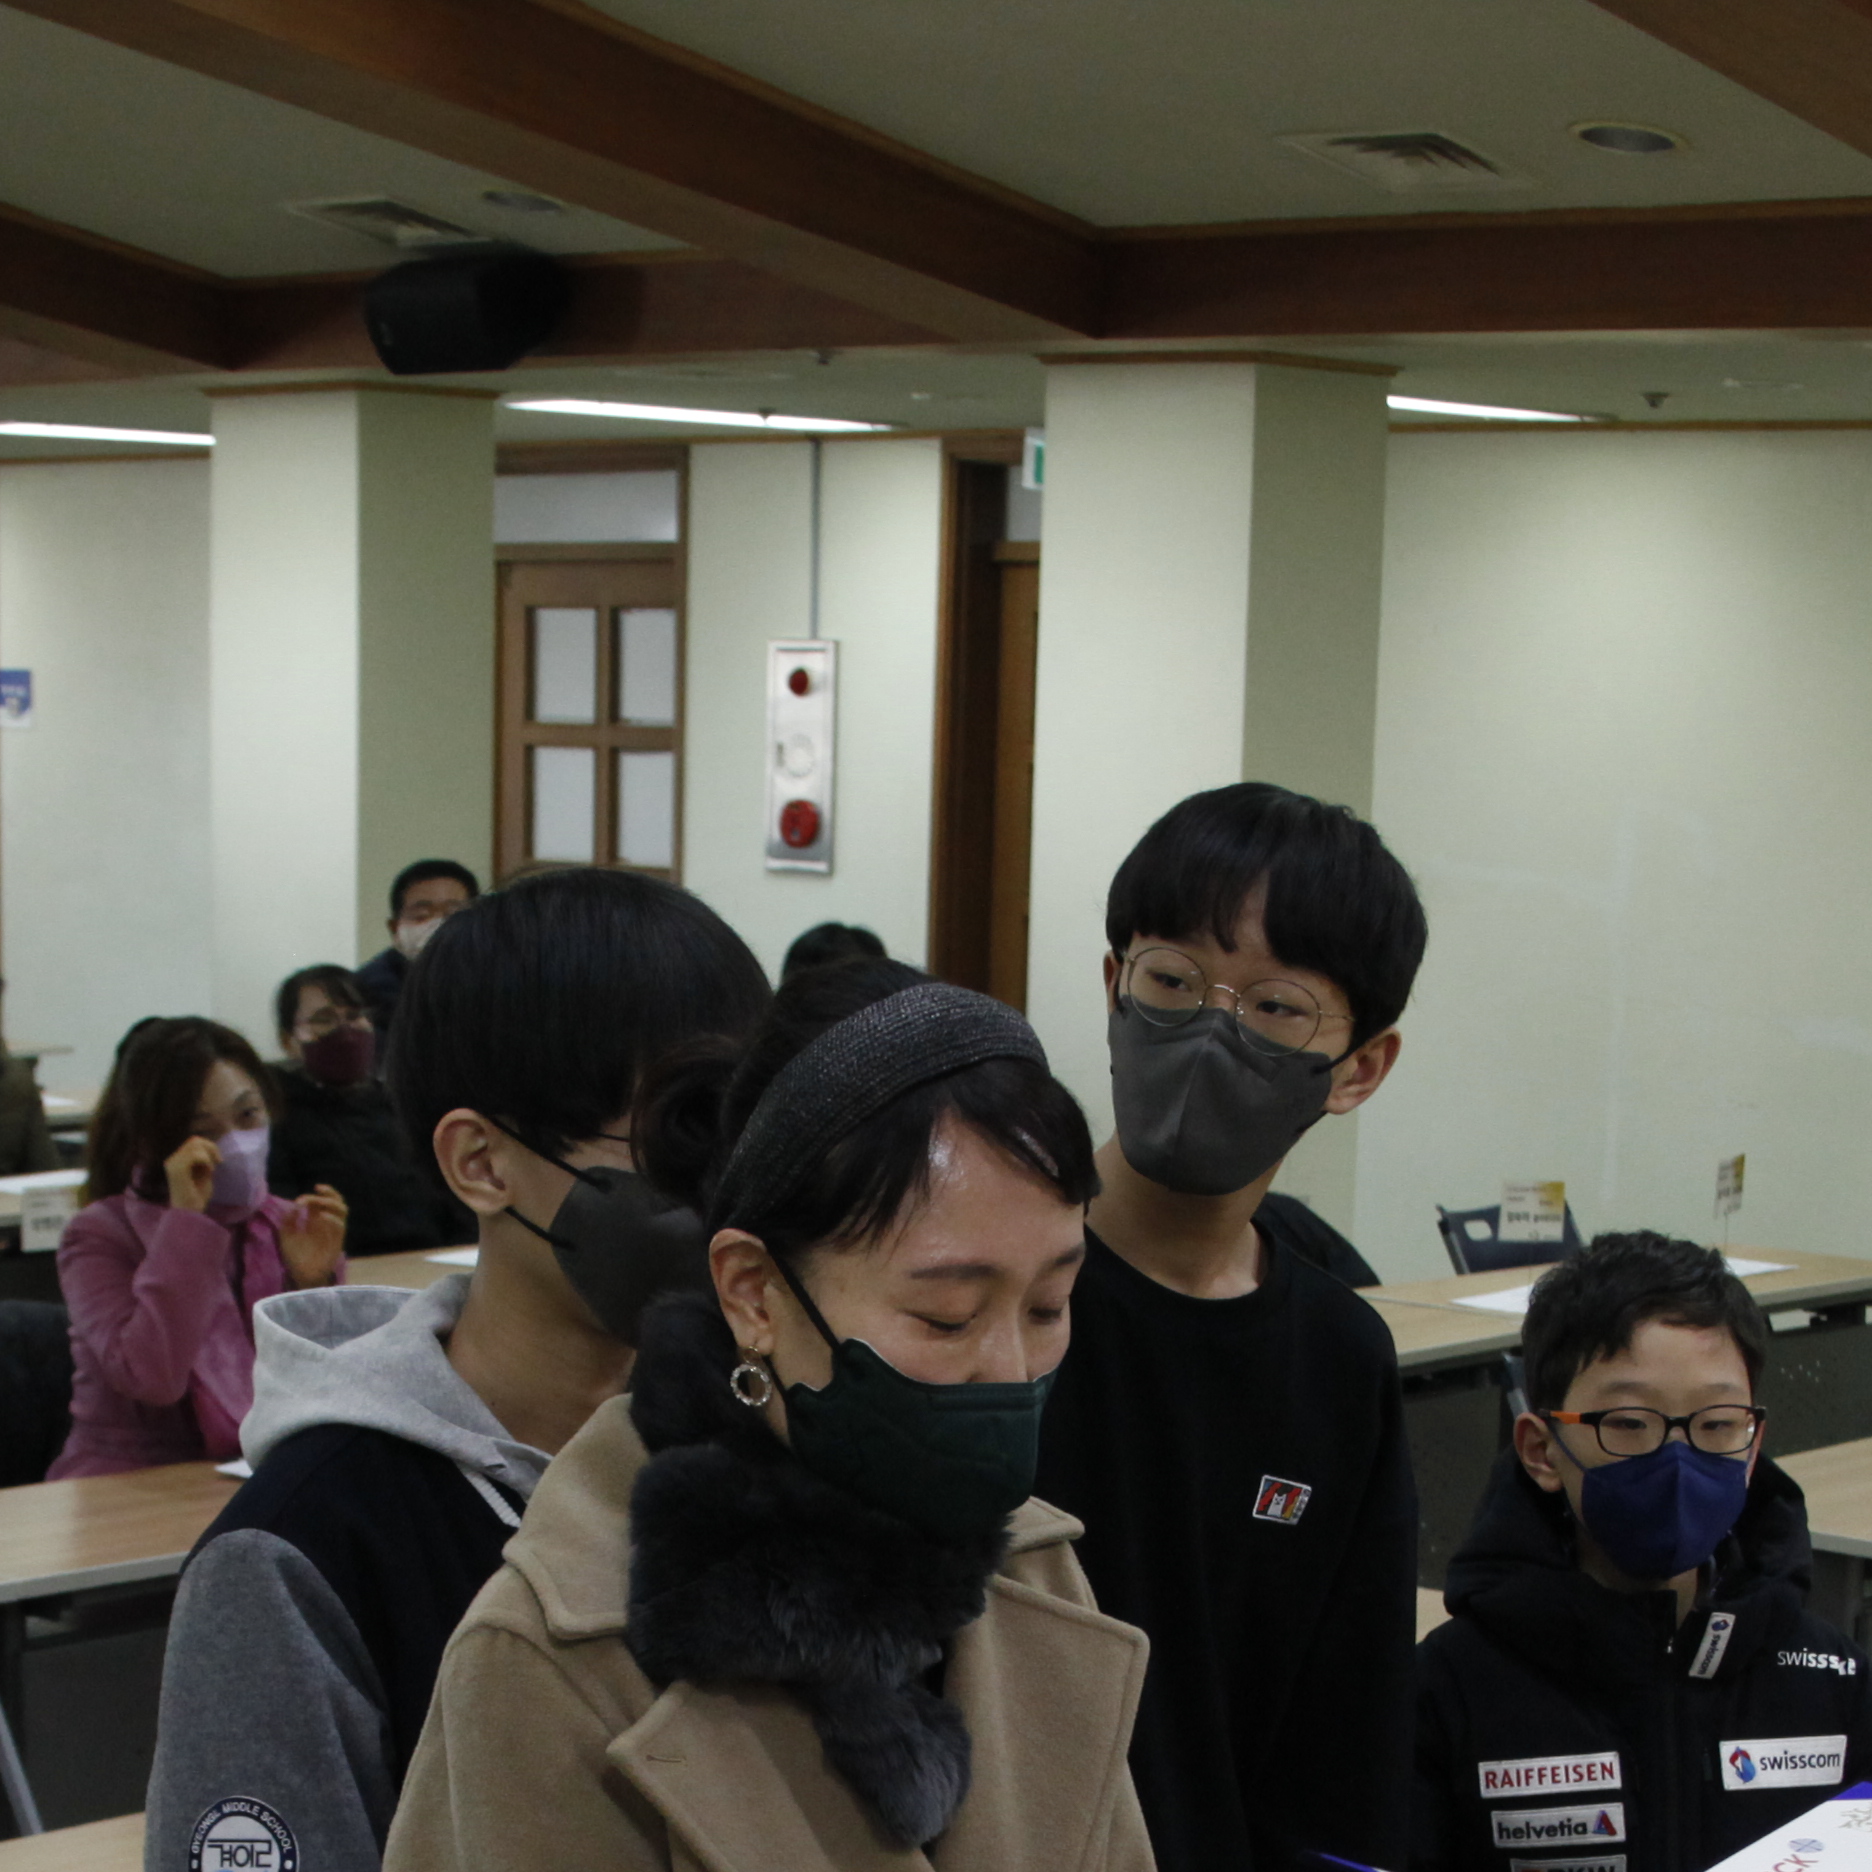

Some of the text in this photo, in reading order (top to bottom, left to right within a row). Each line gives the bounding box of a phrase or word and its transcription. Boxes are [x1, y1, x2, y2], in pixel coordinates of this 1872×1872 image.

[1759, 1750, 1841, 1772] swisscom
[1484, 1761, 1616, 1790] RAIFFEISEN
[221, 1801, 260, 1816] MIDDLE
[259, 1811, 293, 1854] SCHOOL
[1497, 1817, 1588, 1840] helvetia
